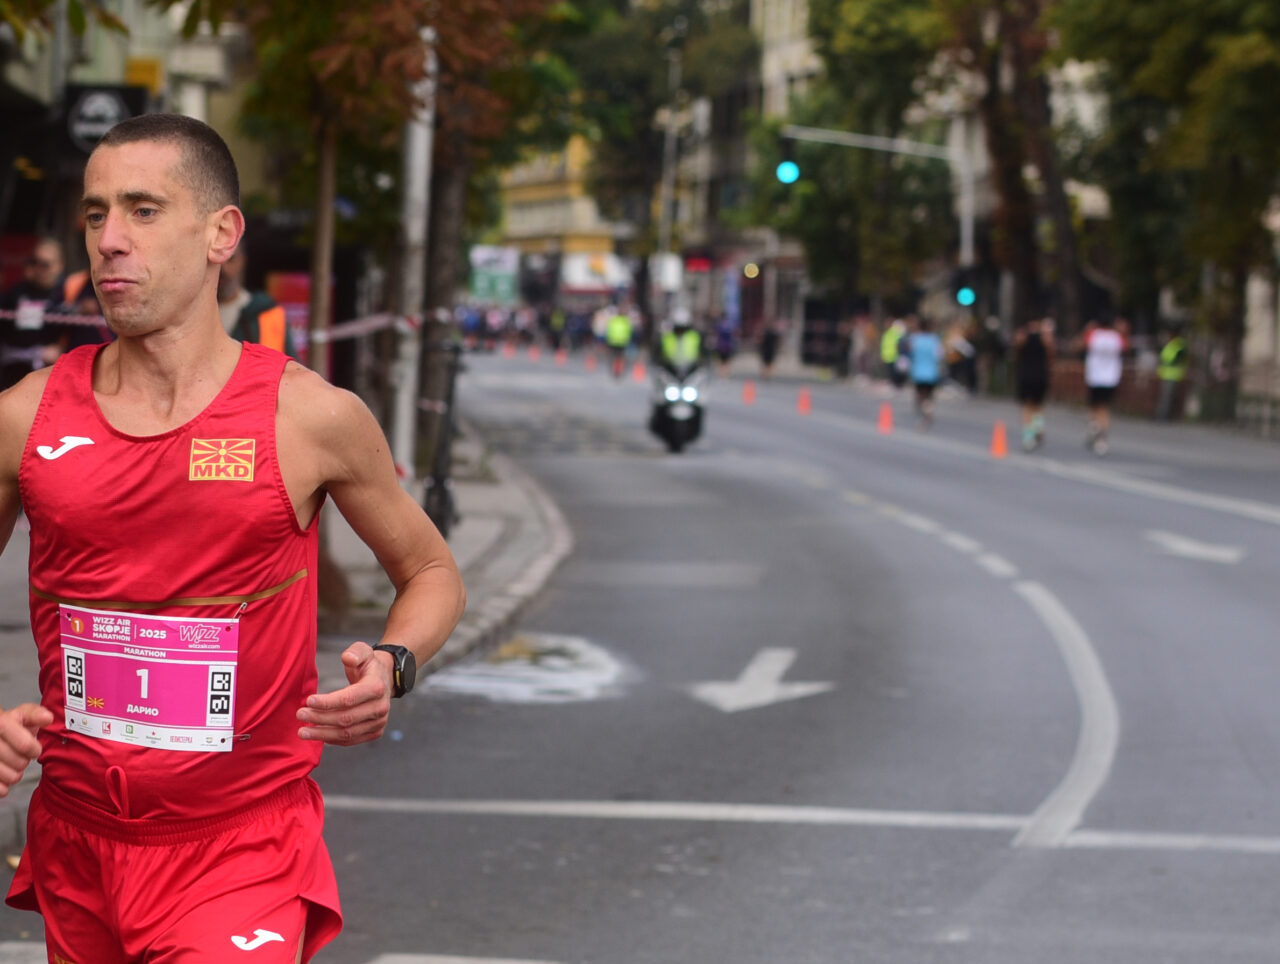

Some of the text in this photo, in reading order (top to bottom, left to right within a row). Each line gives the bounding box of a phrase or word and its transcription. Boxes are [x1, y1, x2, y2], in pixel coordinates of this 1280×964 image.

[193, 464, 250, 478] MKD
[74, 619, 80, 632] 1
[93, 616, 115, 625] WIZZ
[93, 623, 131, 634] SKOPJE
[139, 629, 166, 639] 2025
[93, 632, 131, 642] MARATHON
[124, 647, 166, 657] MARATHON
[135, 668, 149, 699] 1
[126, 704, 159, 716] ДАРИО
